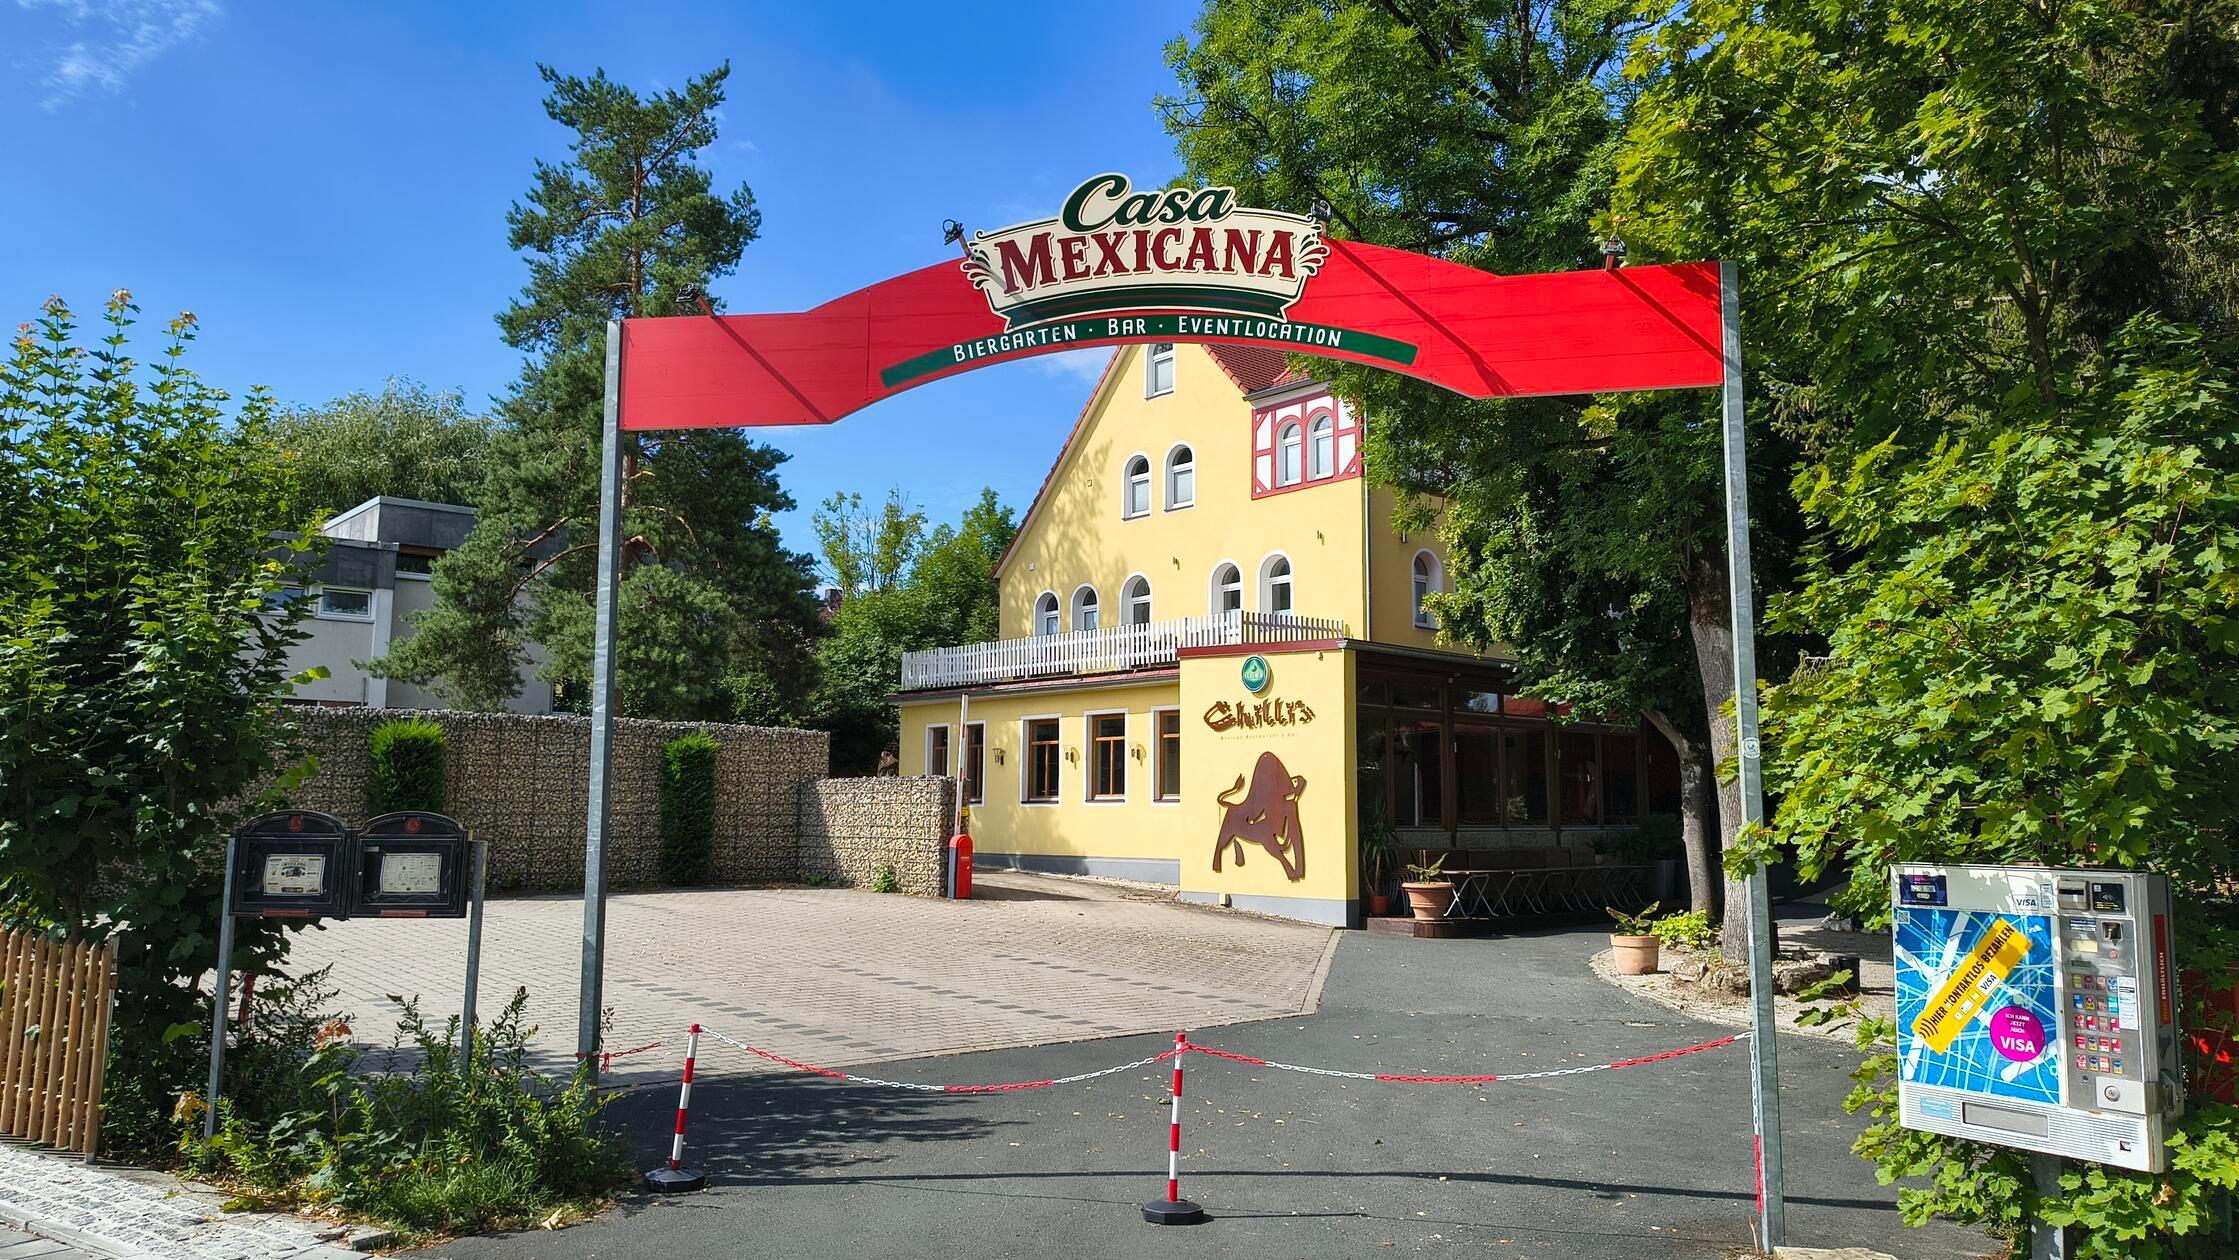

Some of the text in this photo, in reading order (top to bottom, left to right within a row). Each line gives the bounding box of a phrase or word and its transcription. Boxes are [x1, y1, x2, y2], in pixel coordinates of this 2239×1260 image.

[1062, 174, 1234, 232] Casa
[994, 227, 1296, 295] MEXICANA
[953, 316, 1342, 362] BIERGARTEN BAR EVENTLOCATION
[2016, 898, 2037, 907] VISA
[1929, 1005, 1949, 1026] HIER
[1980, 924, 2015, 964] BEZAHLEN
[1979, 974, 1998, 991] VISA
[2000, 1035, 2036, 1054] VISA
